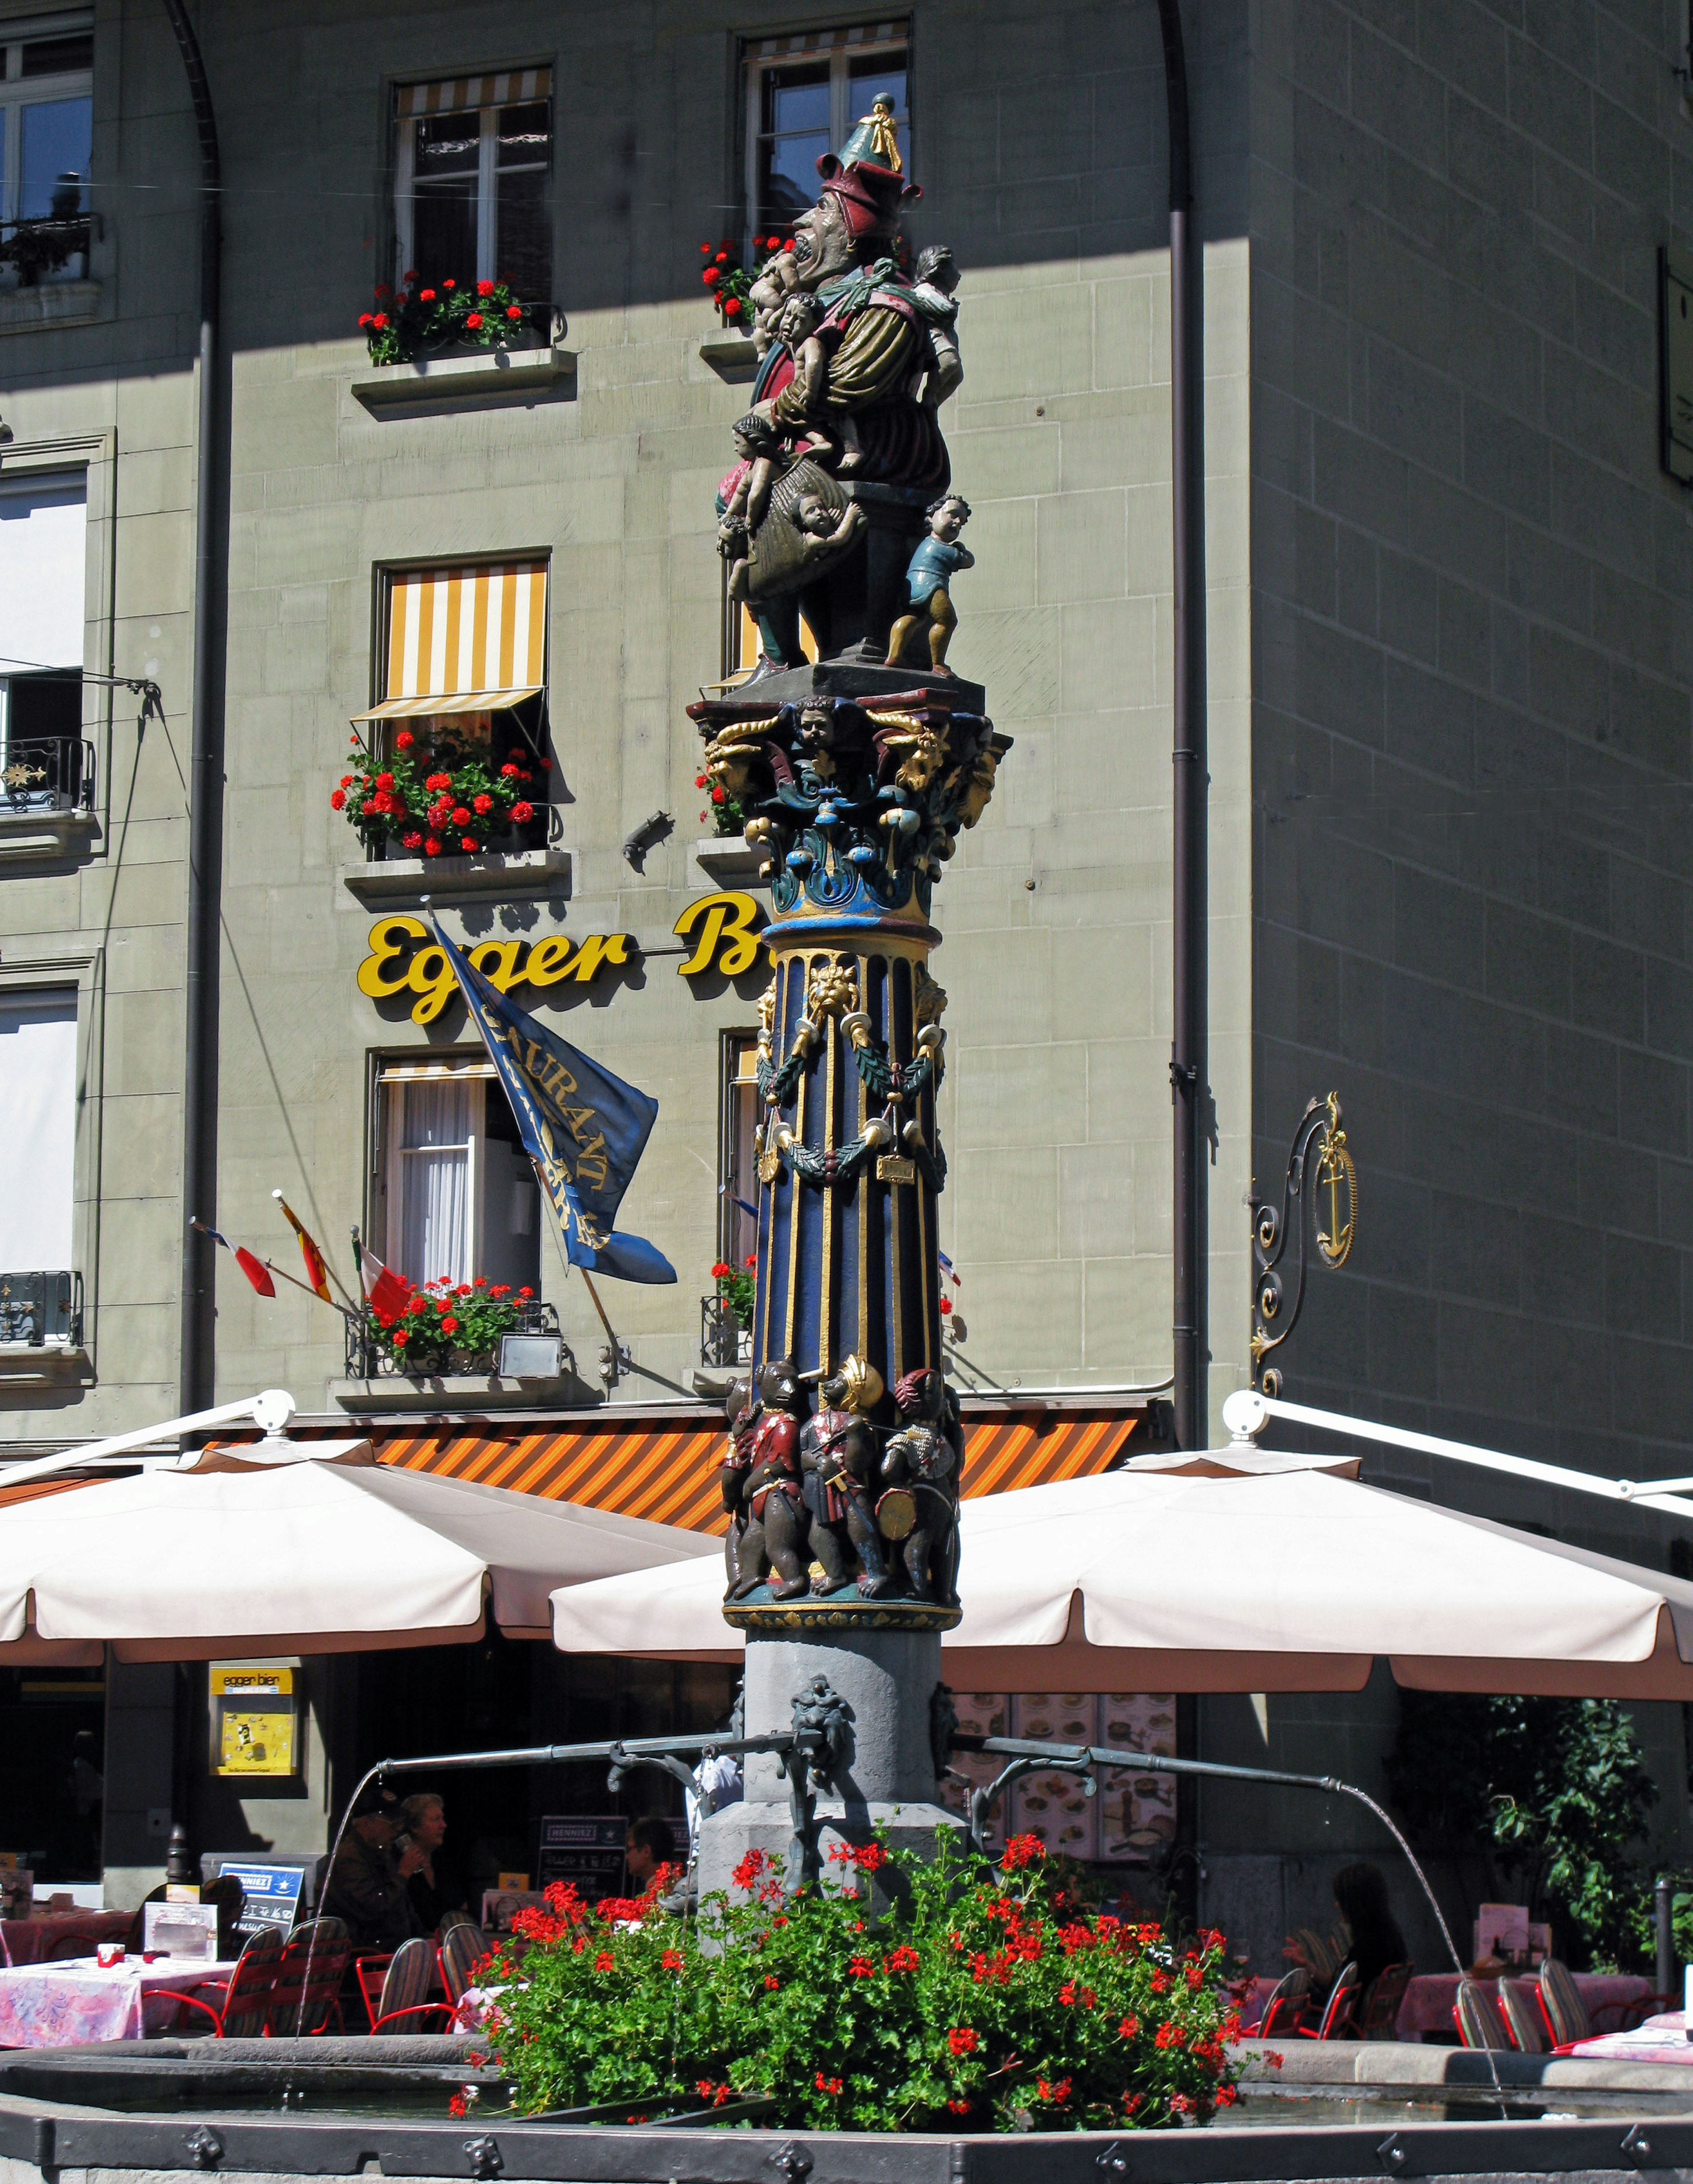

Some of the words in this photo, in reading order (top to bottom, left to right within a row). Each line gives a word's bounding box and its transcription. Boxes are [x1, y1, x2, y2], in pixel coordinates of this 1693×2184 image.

[357, 915, 628, 1026] Egger
[224, 1676, 256, 1687] egger
[258, 1673, 280, 1686] bier
[552, 1829, 592, 1837] HENNIEZ
[239, 1877, 267, 1886] NNIEZ
